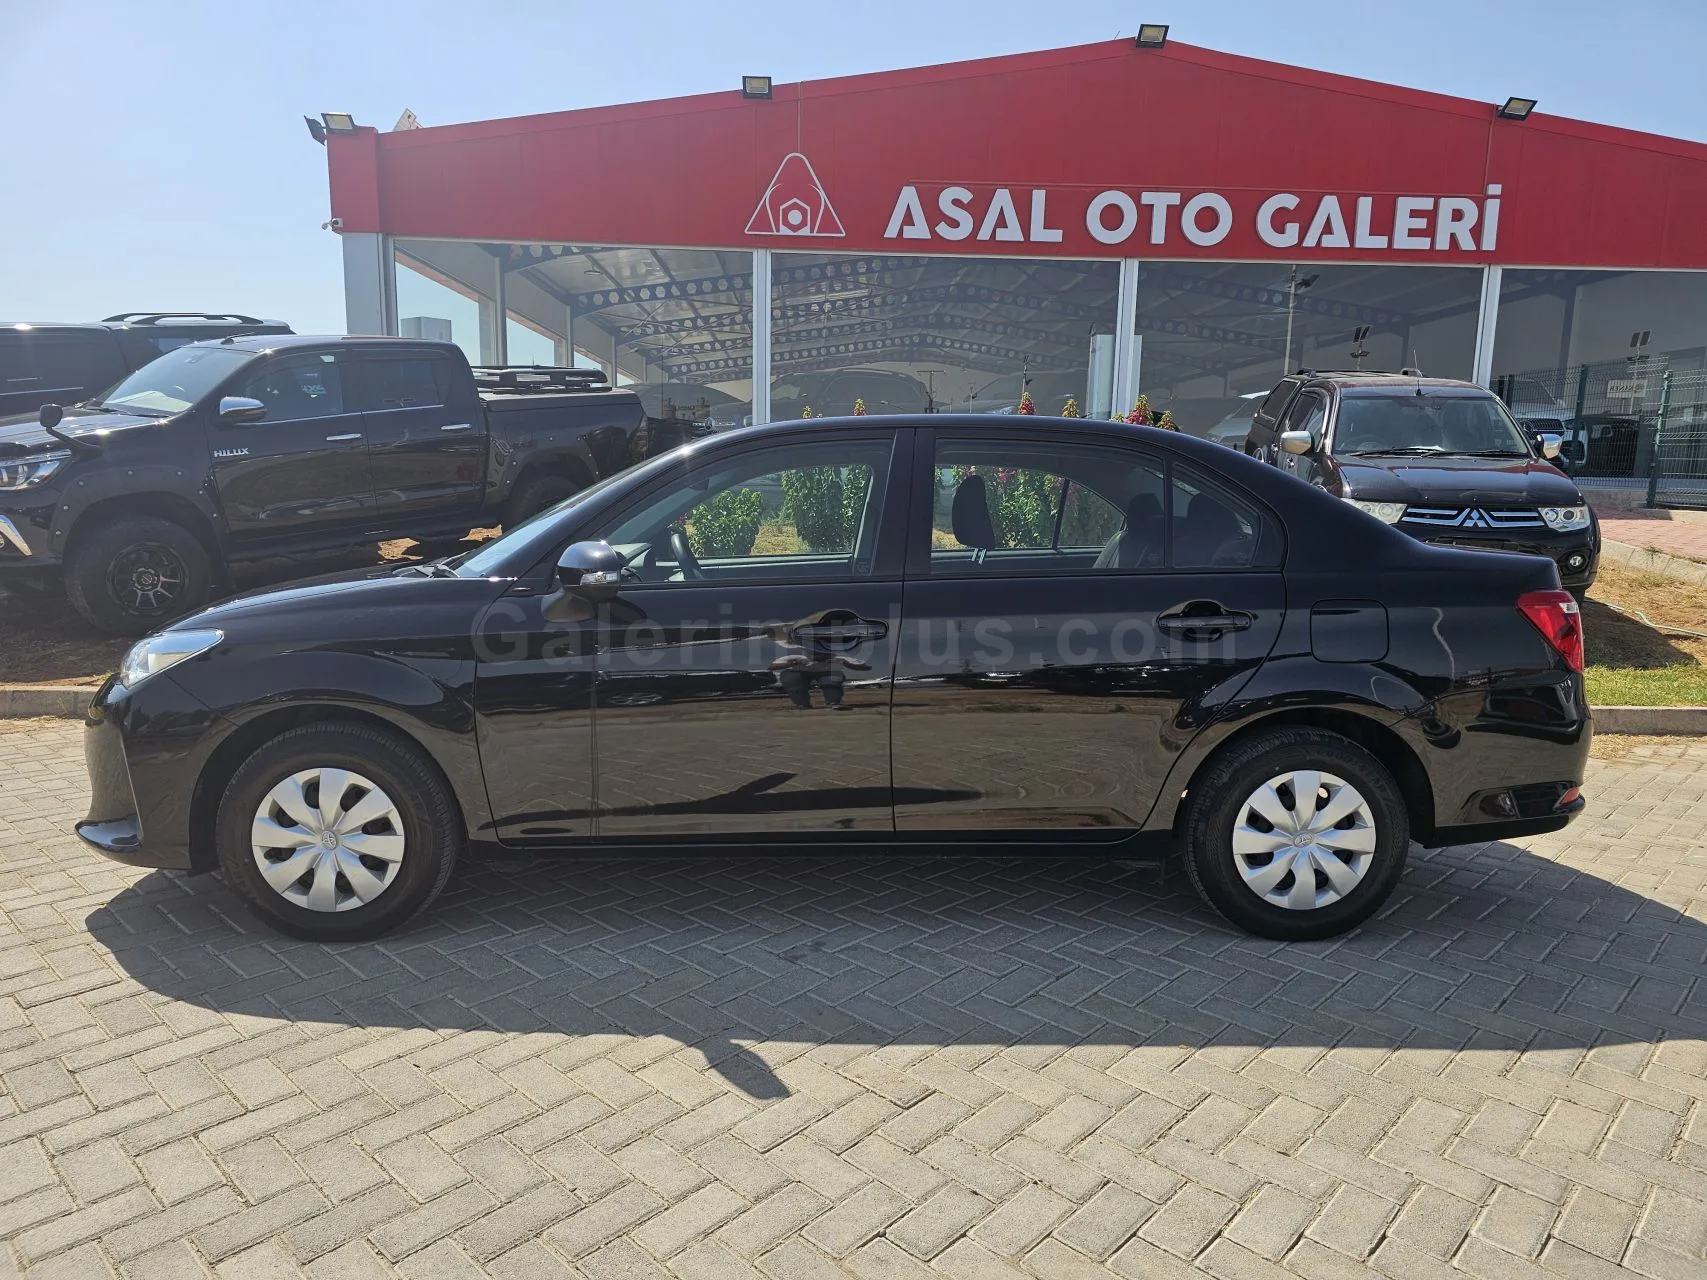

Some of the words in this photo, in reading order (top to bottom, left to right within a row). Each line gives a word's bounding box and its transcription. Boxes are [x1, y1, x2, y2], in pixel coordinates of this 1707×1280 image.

[883, 186, 1063, 243] ASAL
[1086, 190, 1233, 247] OTO
[1255, 183, 1503, 251] GALERİ
[214, 448, 249, 457] HILUX
